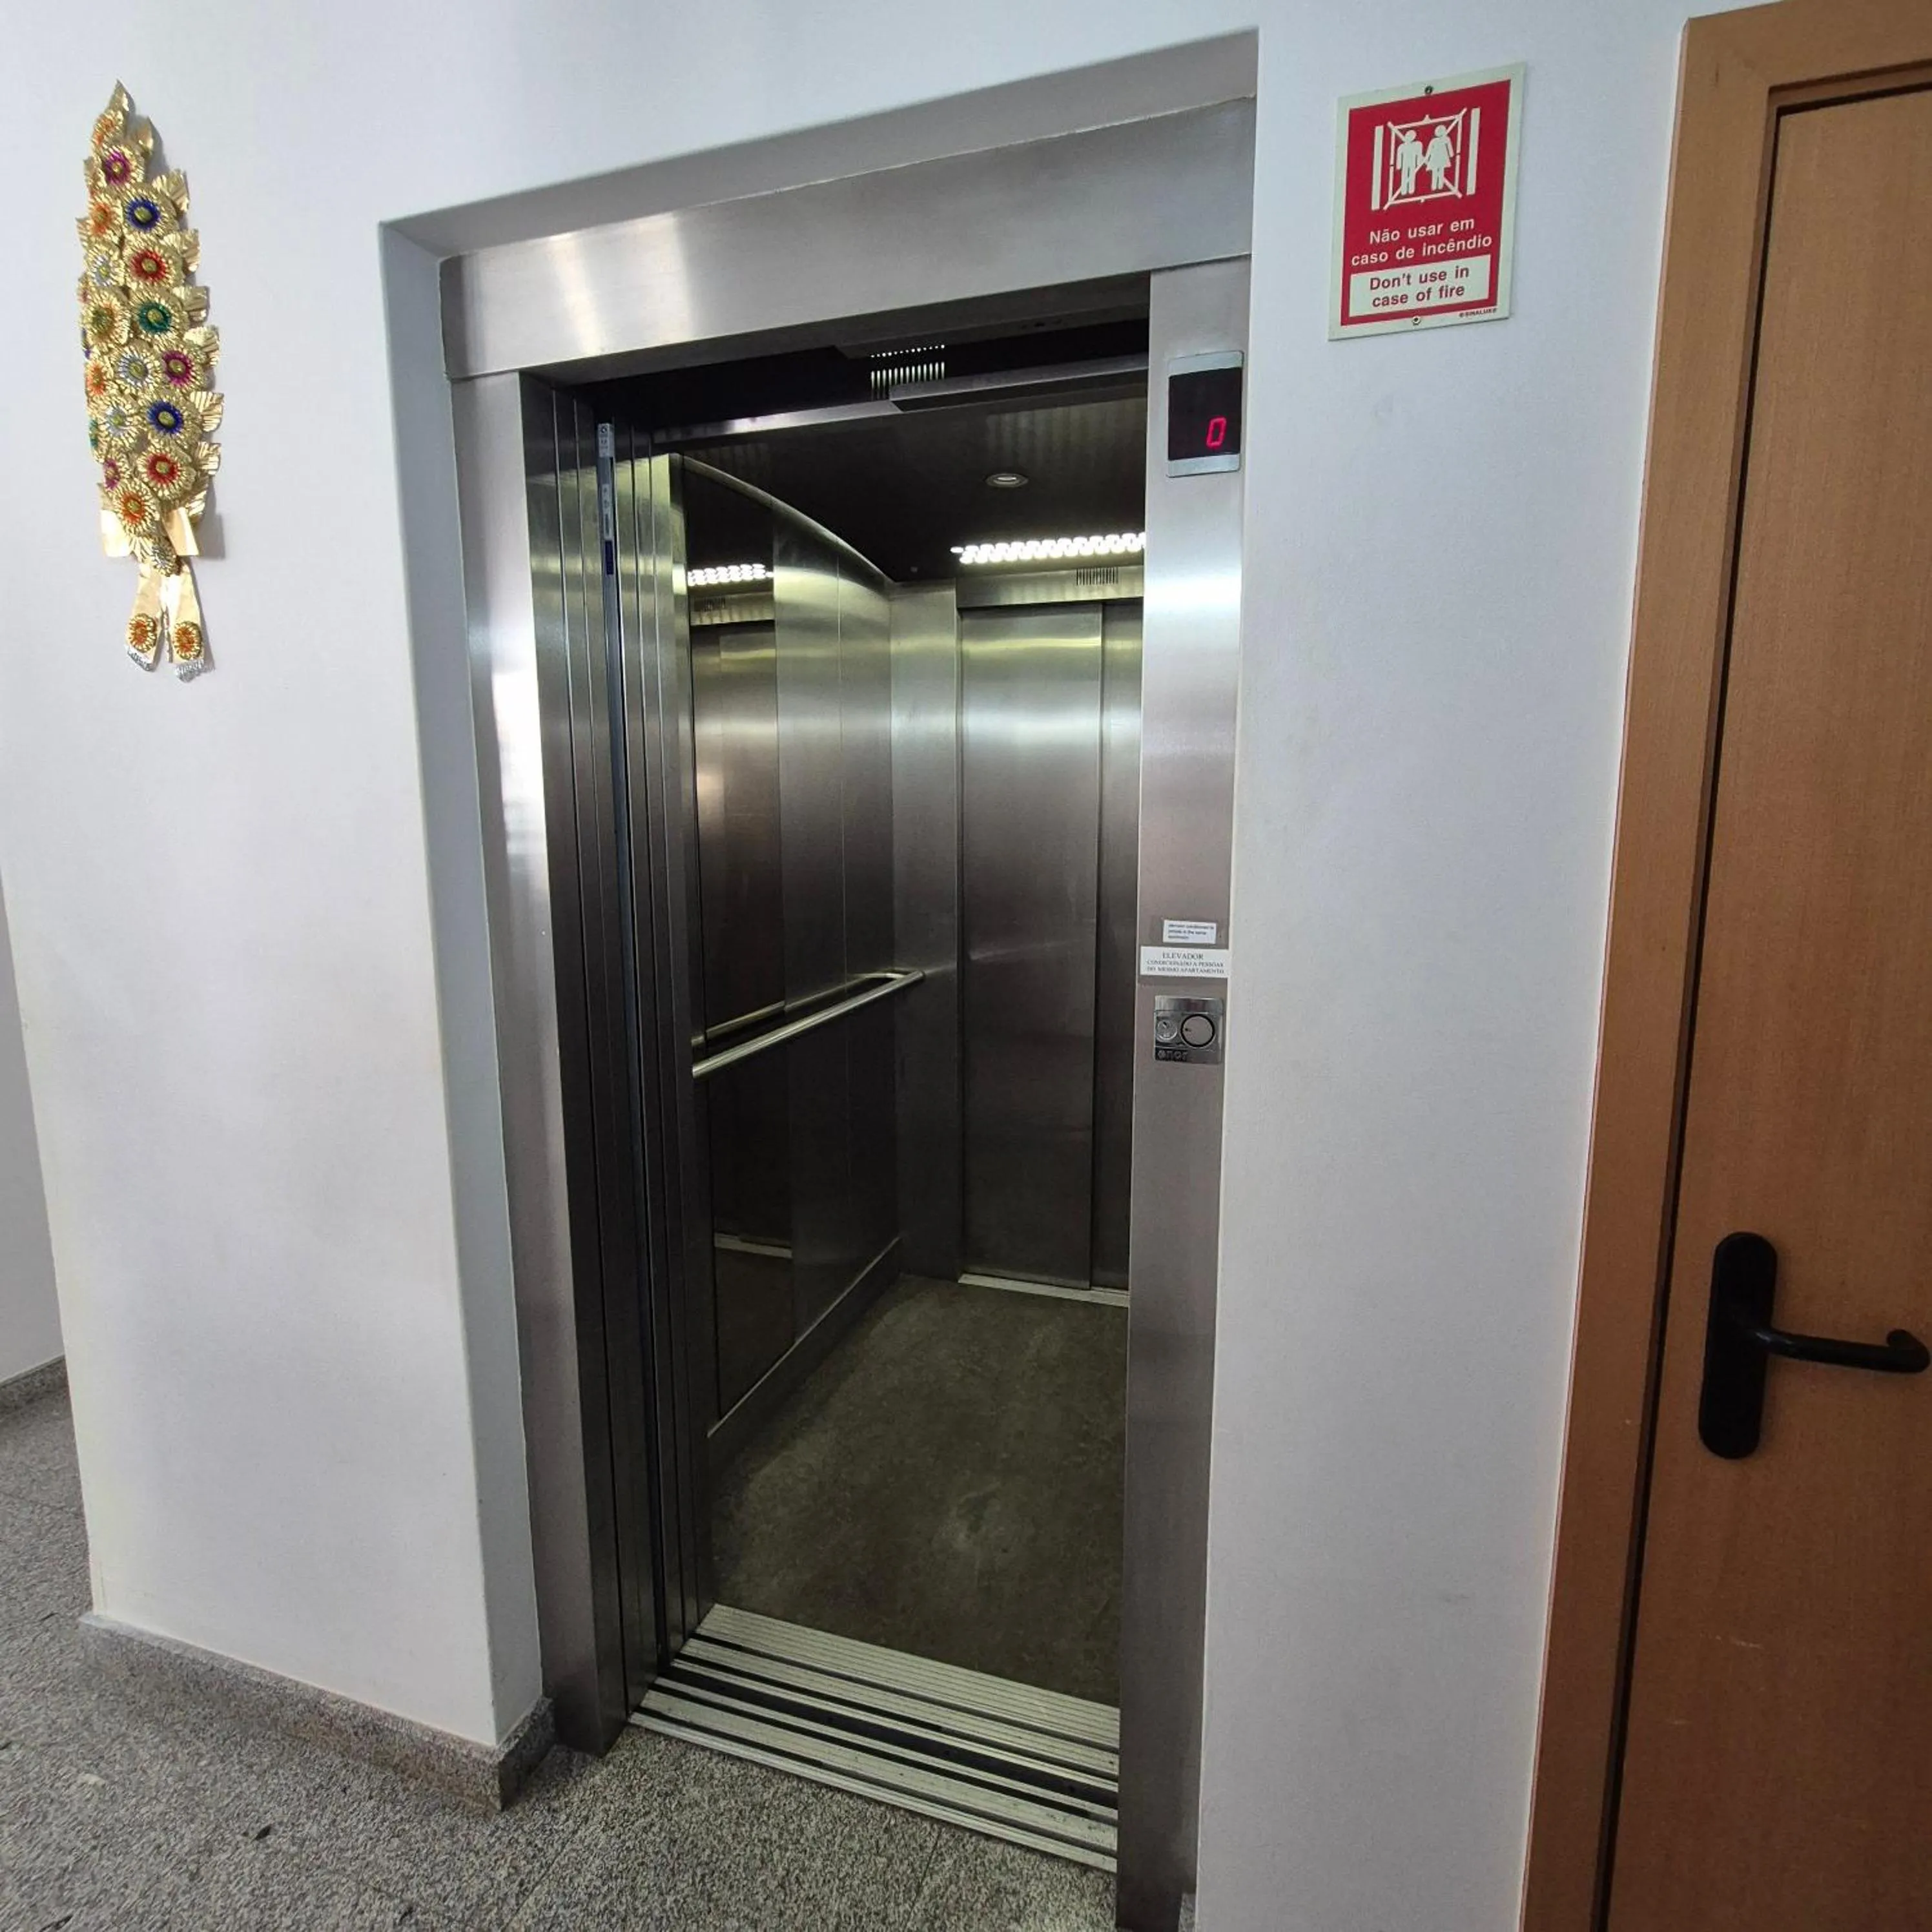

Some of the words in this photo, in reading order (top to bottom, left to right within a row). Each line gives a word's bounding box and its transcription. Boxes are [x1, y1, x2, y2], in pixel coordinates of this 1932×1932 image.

[1370, 228, 1401, 244] Não
[1408, 223, 1443, 238] usar
[1450, 218, 1475, 232] em
[1351, 251, 1388, 266] caso
[1396, 245, 1415, 260] de
[1422, 235, 1492, 256] incêndio
[1370, 272, 1412, 291] Don't
[1419, 269, 1447, 283] use
[1455, 265, 1469, 279] in
[1372, 293, 1408, 307] case
[1416, 288, 1432, 302] of
[1439, 284, 1465, 299] fire
[1206, 416, 1226, 447] 0
[1162, 951, 1204, 960] ELEVADOR
